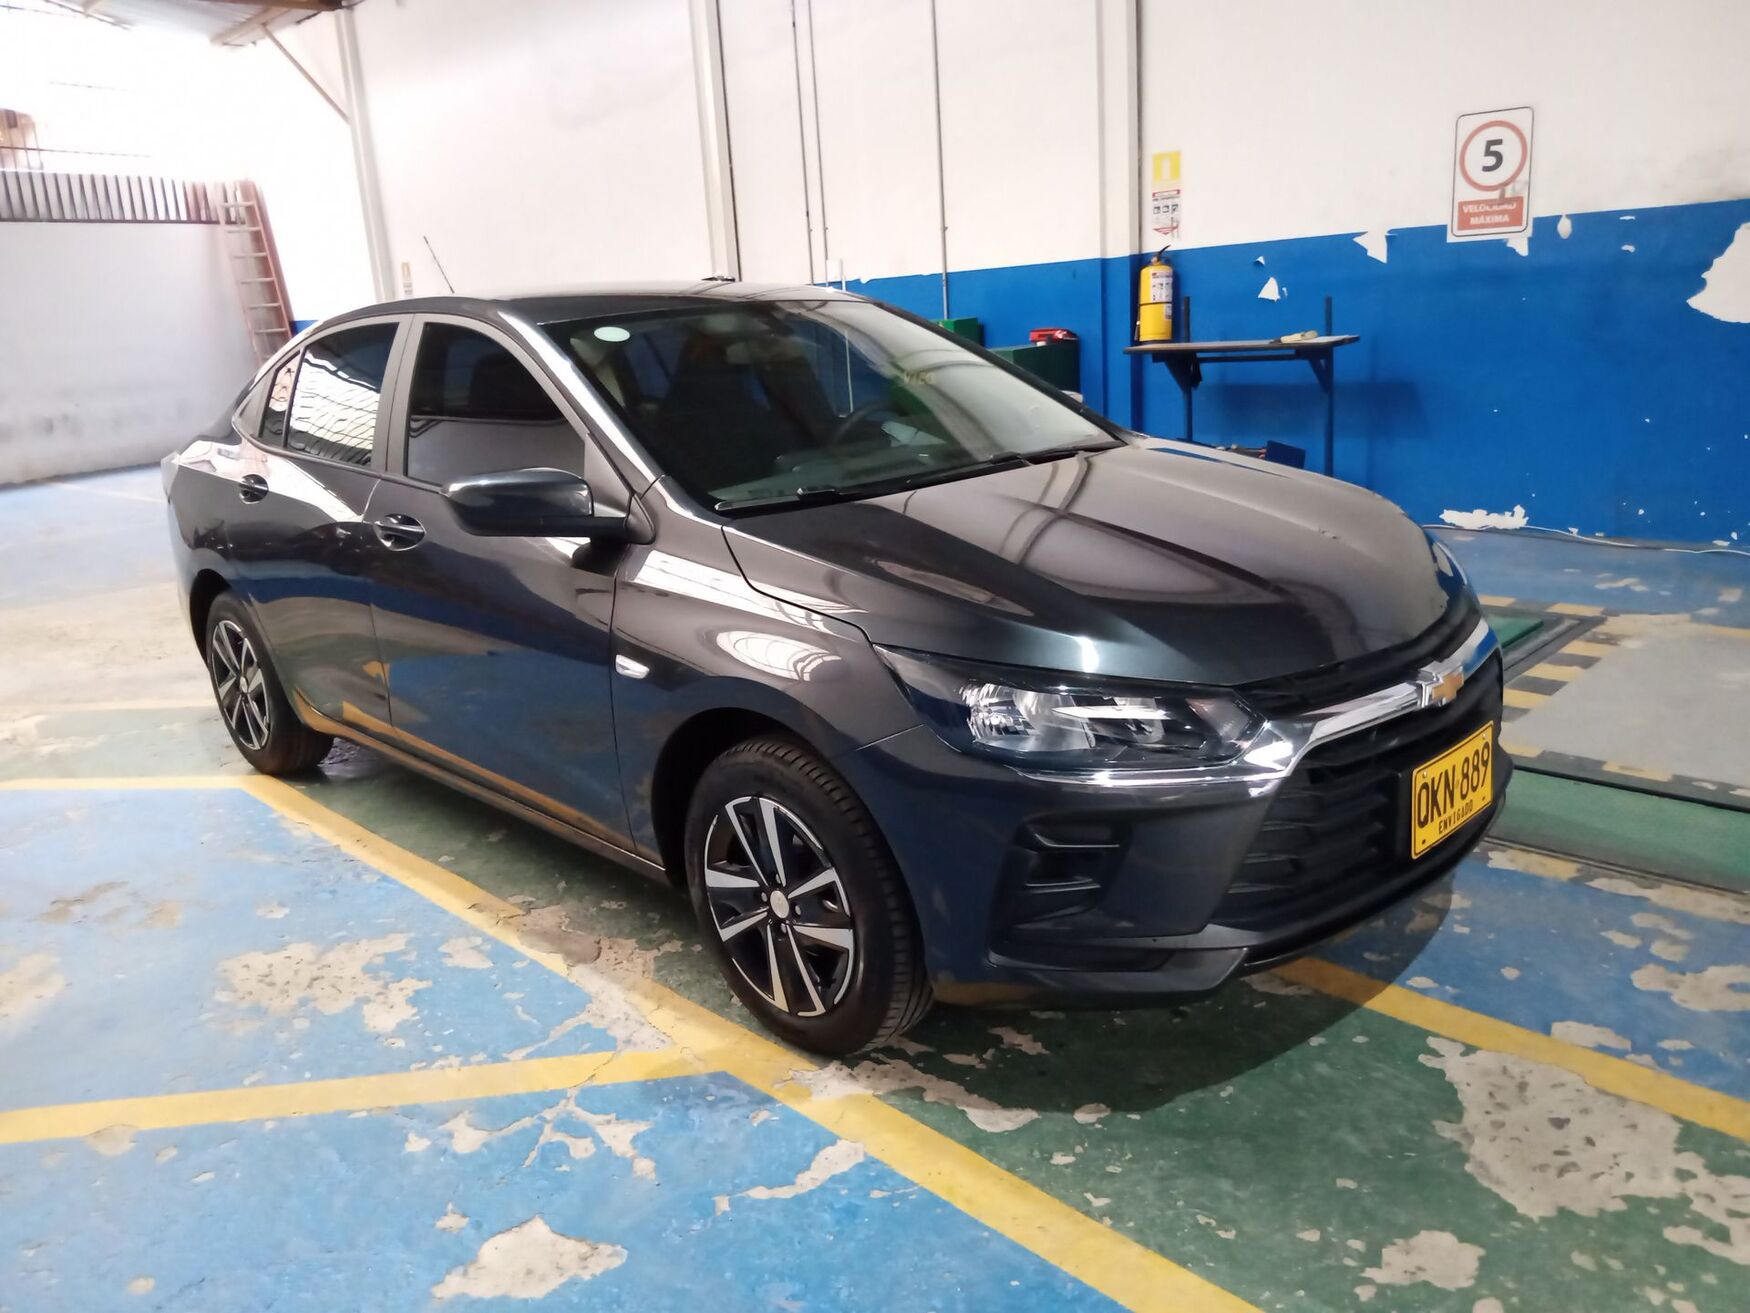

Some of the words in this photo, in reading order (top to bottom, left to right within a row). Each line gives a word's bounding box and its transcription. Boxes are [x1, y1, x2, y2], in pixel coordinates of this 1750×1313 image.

[1481, 138, 1504, 172] 5
[1469, 213, 1510, 225] MÁXIMA
[1417, 764, 1456, 829] OKN
[1460, 741, 1490, 801] 889
[1438, 799, 1474, 834] ENVIGADO
